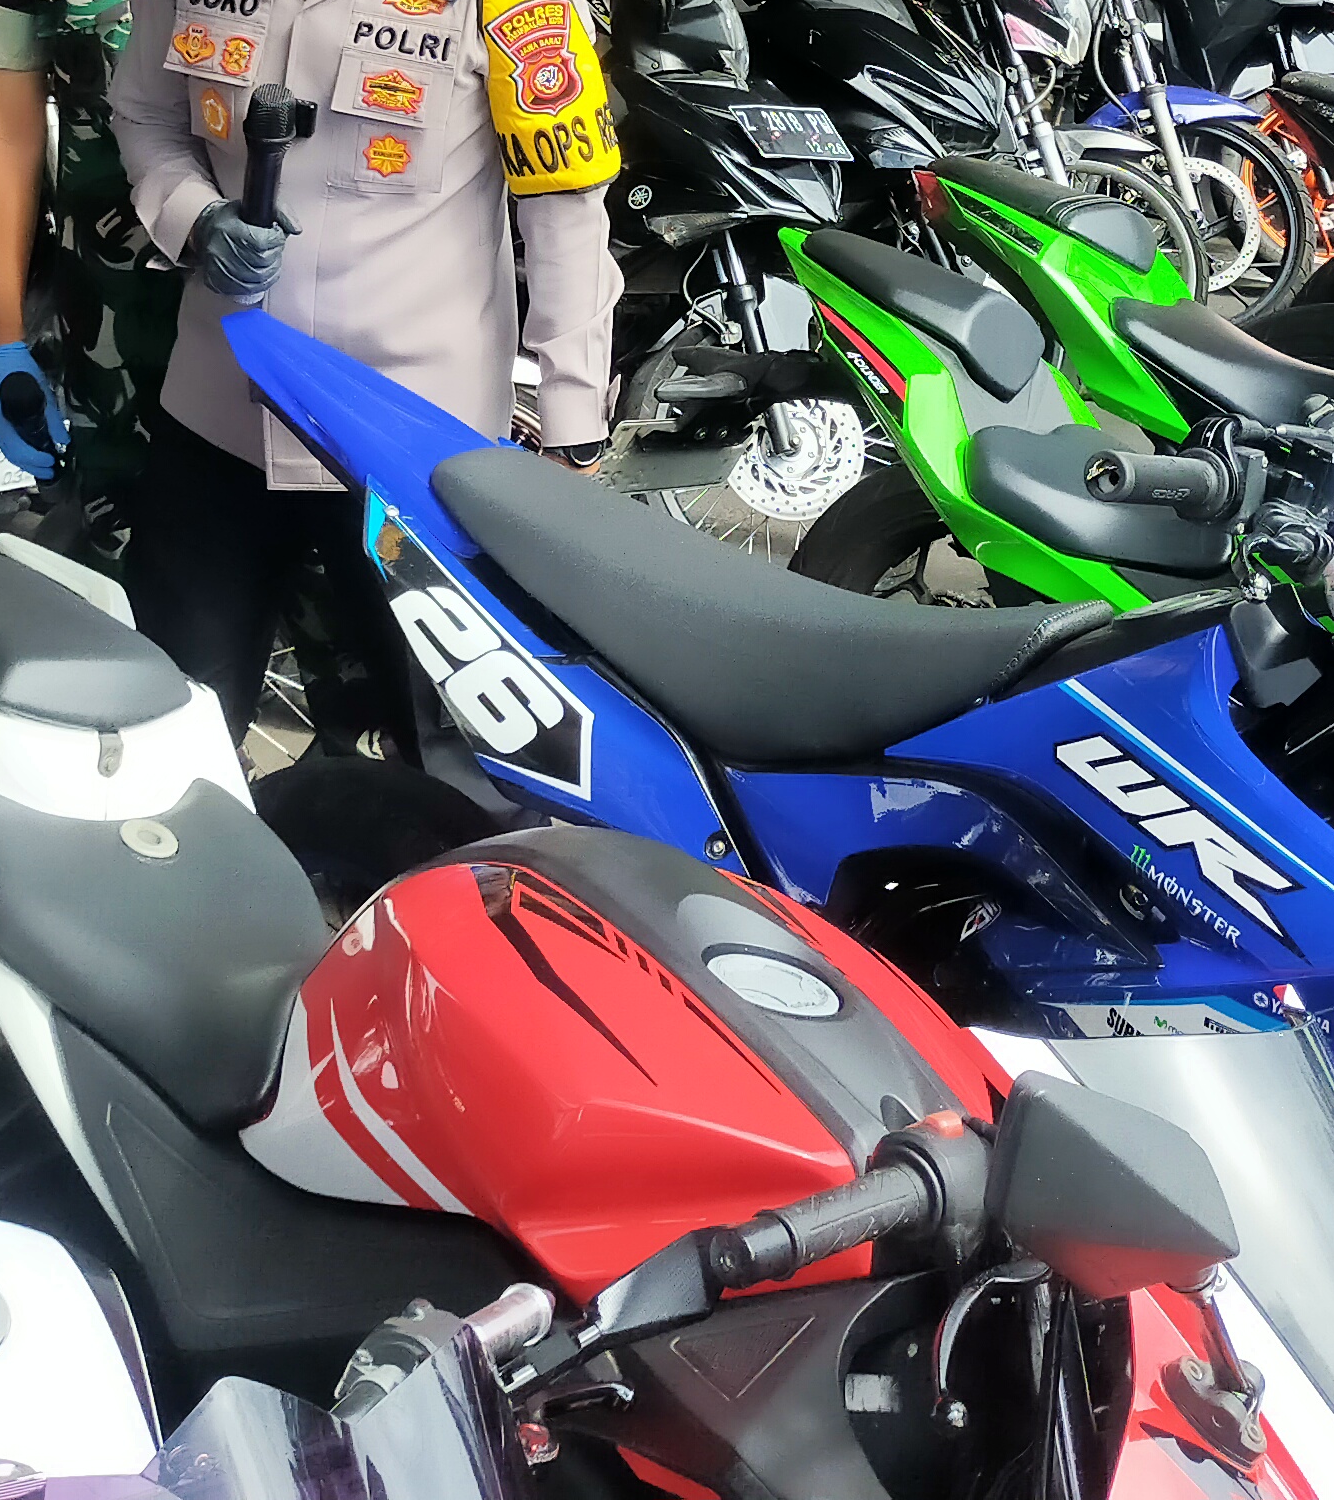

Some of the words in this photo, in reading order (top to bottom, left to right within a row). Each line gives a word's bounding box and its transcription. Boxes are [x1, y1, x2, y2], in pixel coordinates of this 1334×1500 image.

[353, 20, 452, 62] POLRI
[501, 4, 564, 35] POLRES
[533, 116, 594, 174] OPS
[389, 585, 565, 756] 26
[1053, 733, 1297, 941] WR
